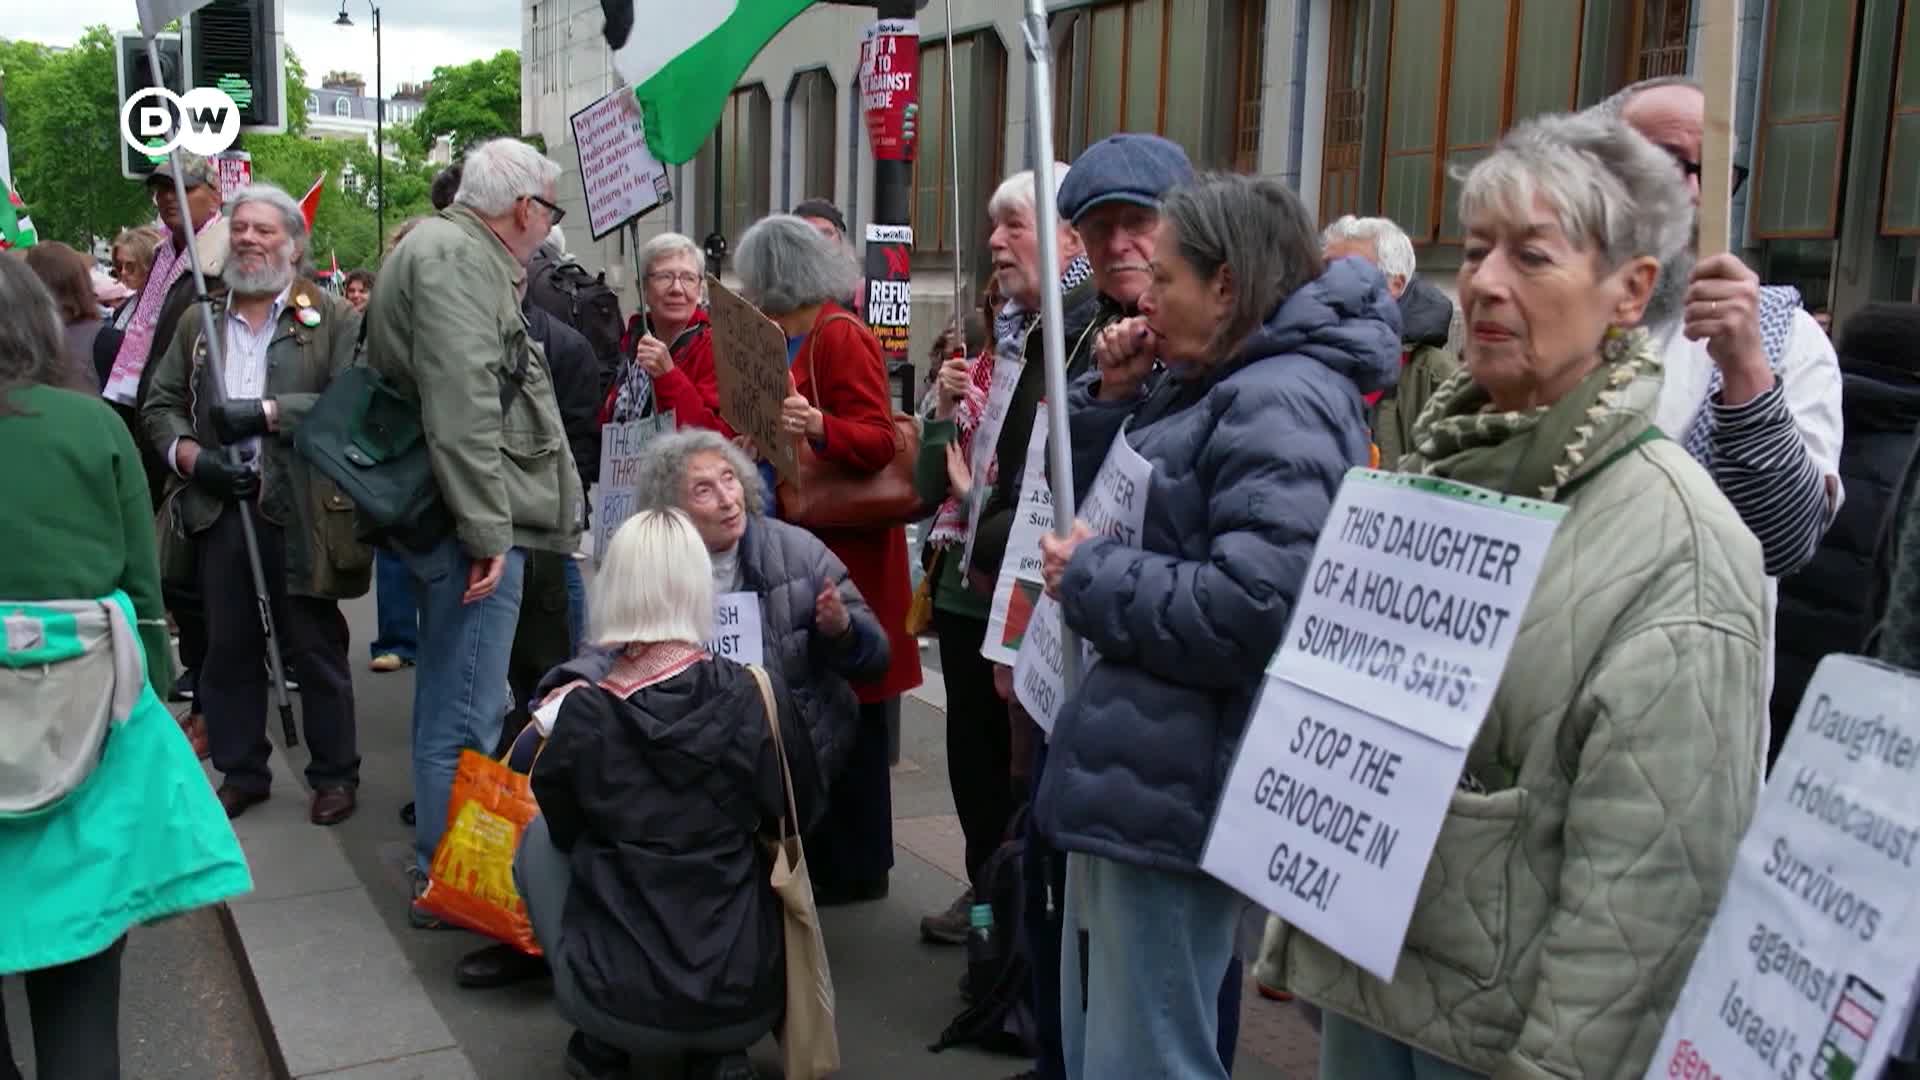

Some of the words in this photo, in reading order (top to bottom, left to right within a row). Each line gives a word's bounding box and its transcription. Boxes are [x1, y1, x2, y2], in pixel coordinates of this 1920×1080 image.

[878, 55, 891, 73] TO
[1031, 489, 1040, 504] A
[1340, 505, 1385, 549] THIS
[1383, 514, 1521, 586] DAUGHTER
[1314, 559, 1345, 598] OF
[1339, 567, 1358, 606] A
[1359, 570, 1511, 650] HOLOCAUST
[1299, 613, 1407, 685] SURVIVOR
[1403, 651, 1479, 712] SAYS:
[1289, 716, 1352, 770] STOP
[1349, 740, 1403, 797] THE
[1254, 766, 1373, 855] GENOCIDE
[1364, 820, 1400, 871] IN
[1789, 765, 1920, 869] Holocaust
[1267, 841, 1342, 913] GAZA!
[1763, 836, 1883, 943] Survivors
[1748, 923, 1839, 1014] against
